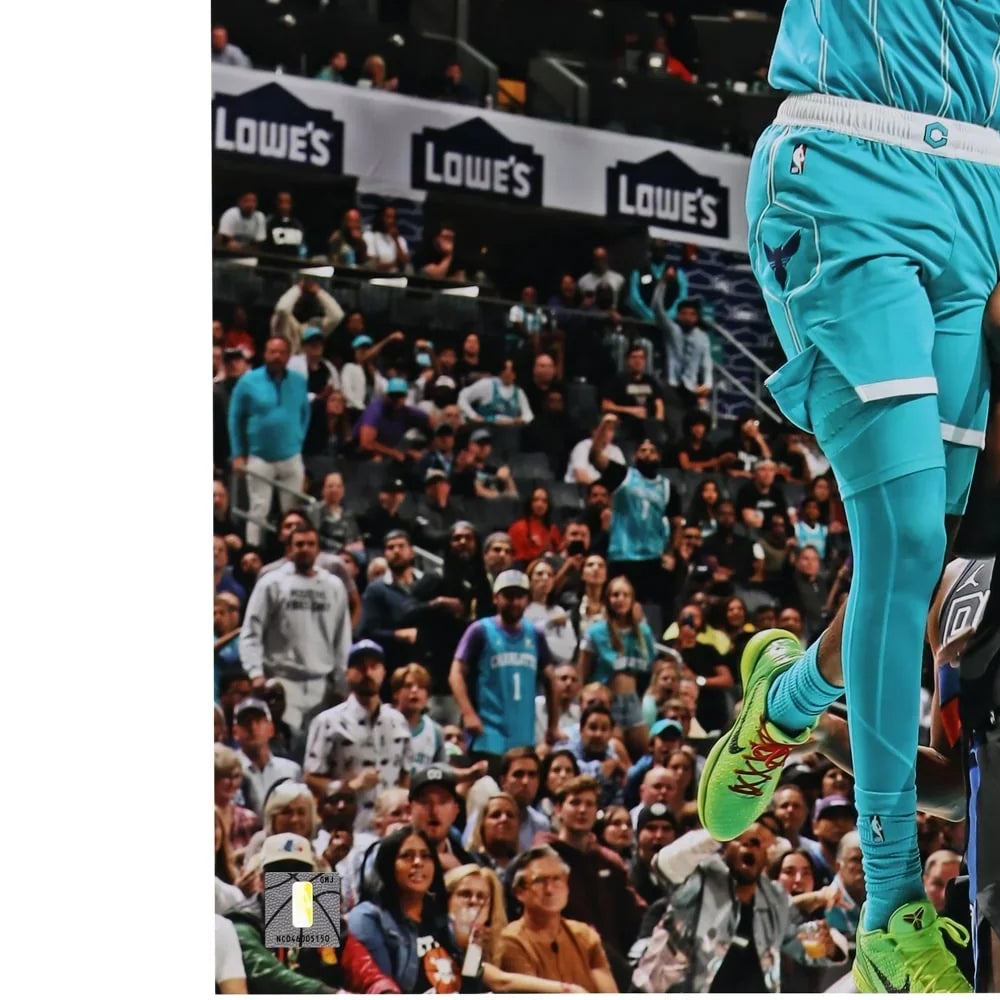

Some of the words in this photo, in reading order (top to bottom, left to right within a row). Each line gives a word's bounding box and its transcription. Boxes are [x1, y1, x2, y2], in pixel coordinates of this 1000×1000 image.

[215, 106, 333, 167] LOWE'S
[425, 141, 533, 198] LOWE'S
[618, 174, 718, 228] LOWE'S
[513, 672, 521, 701] 1
